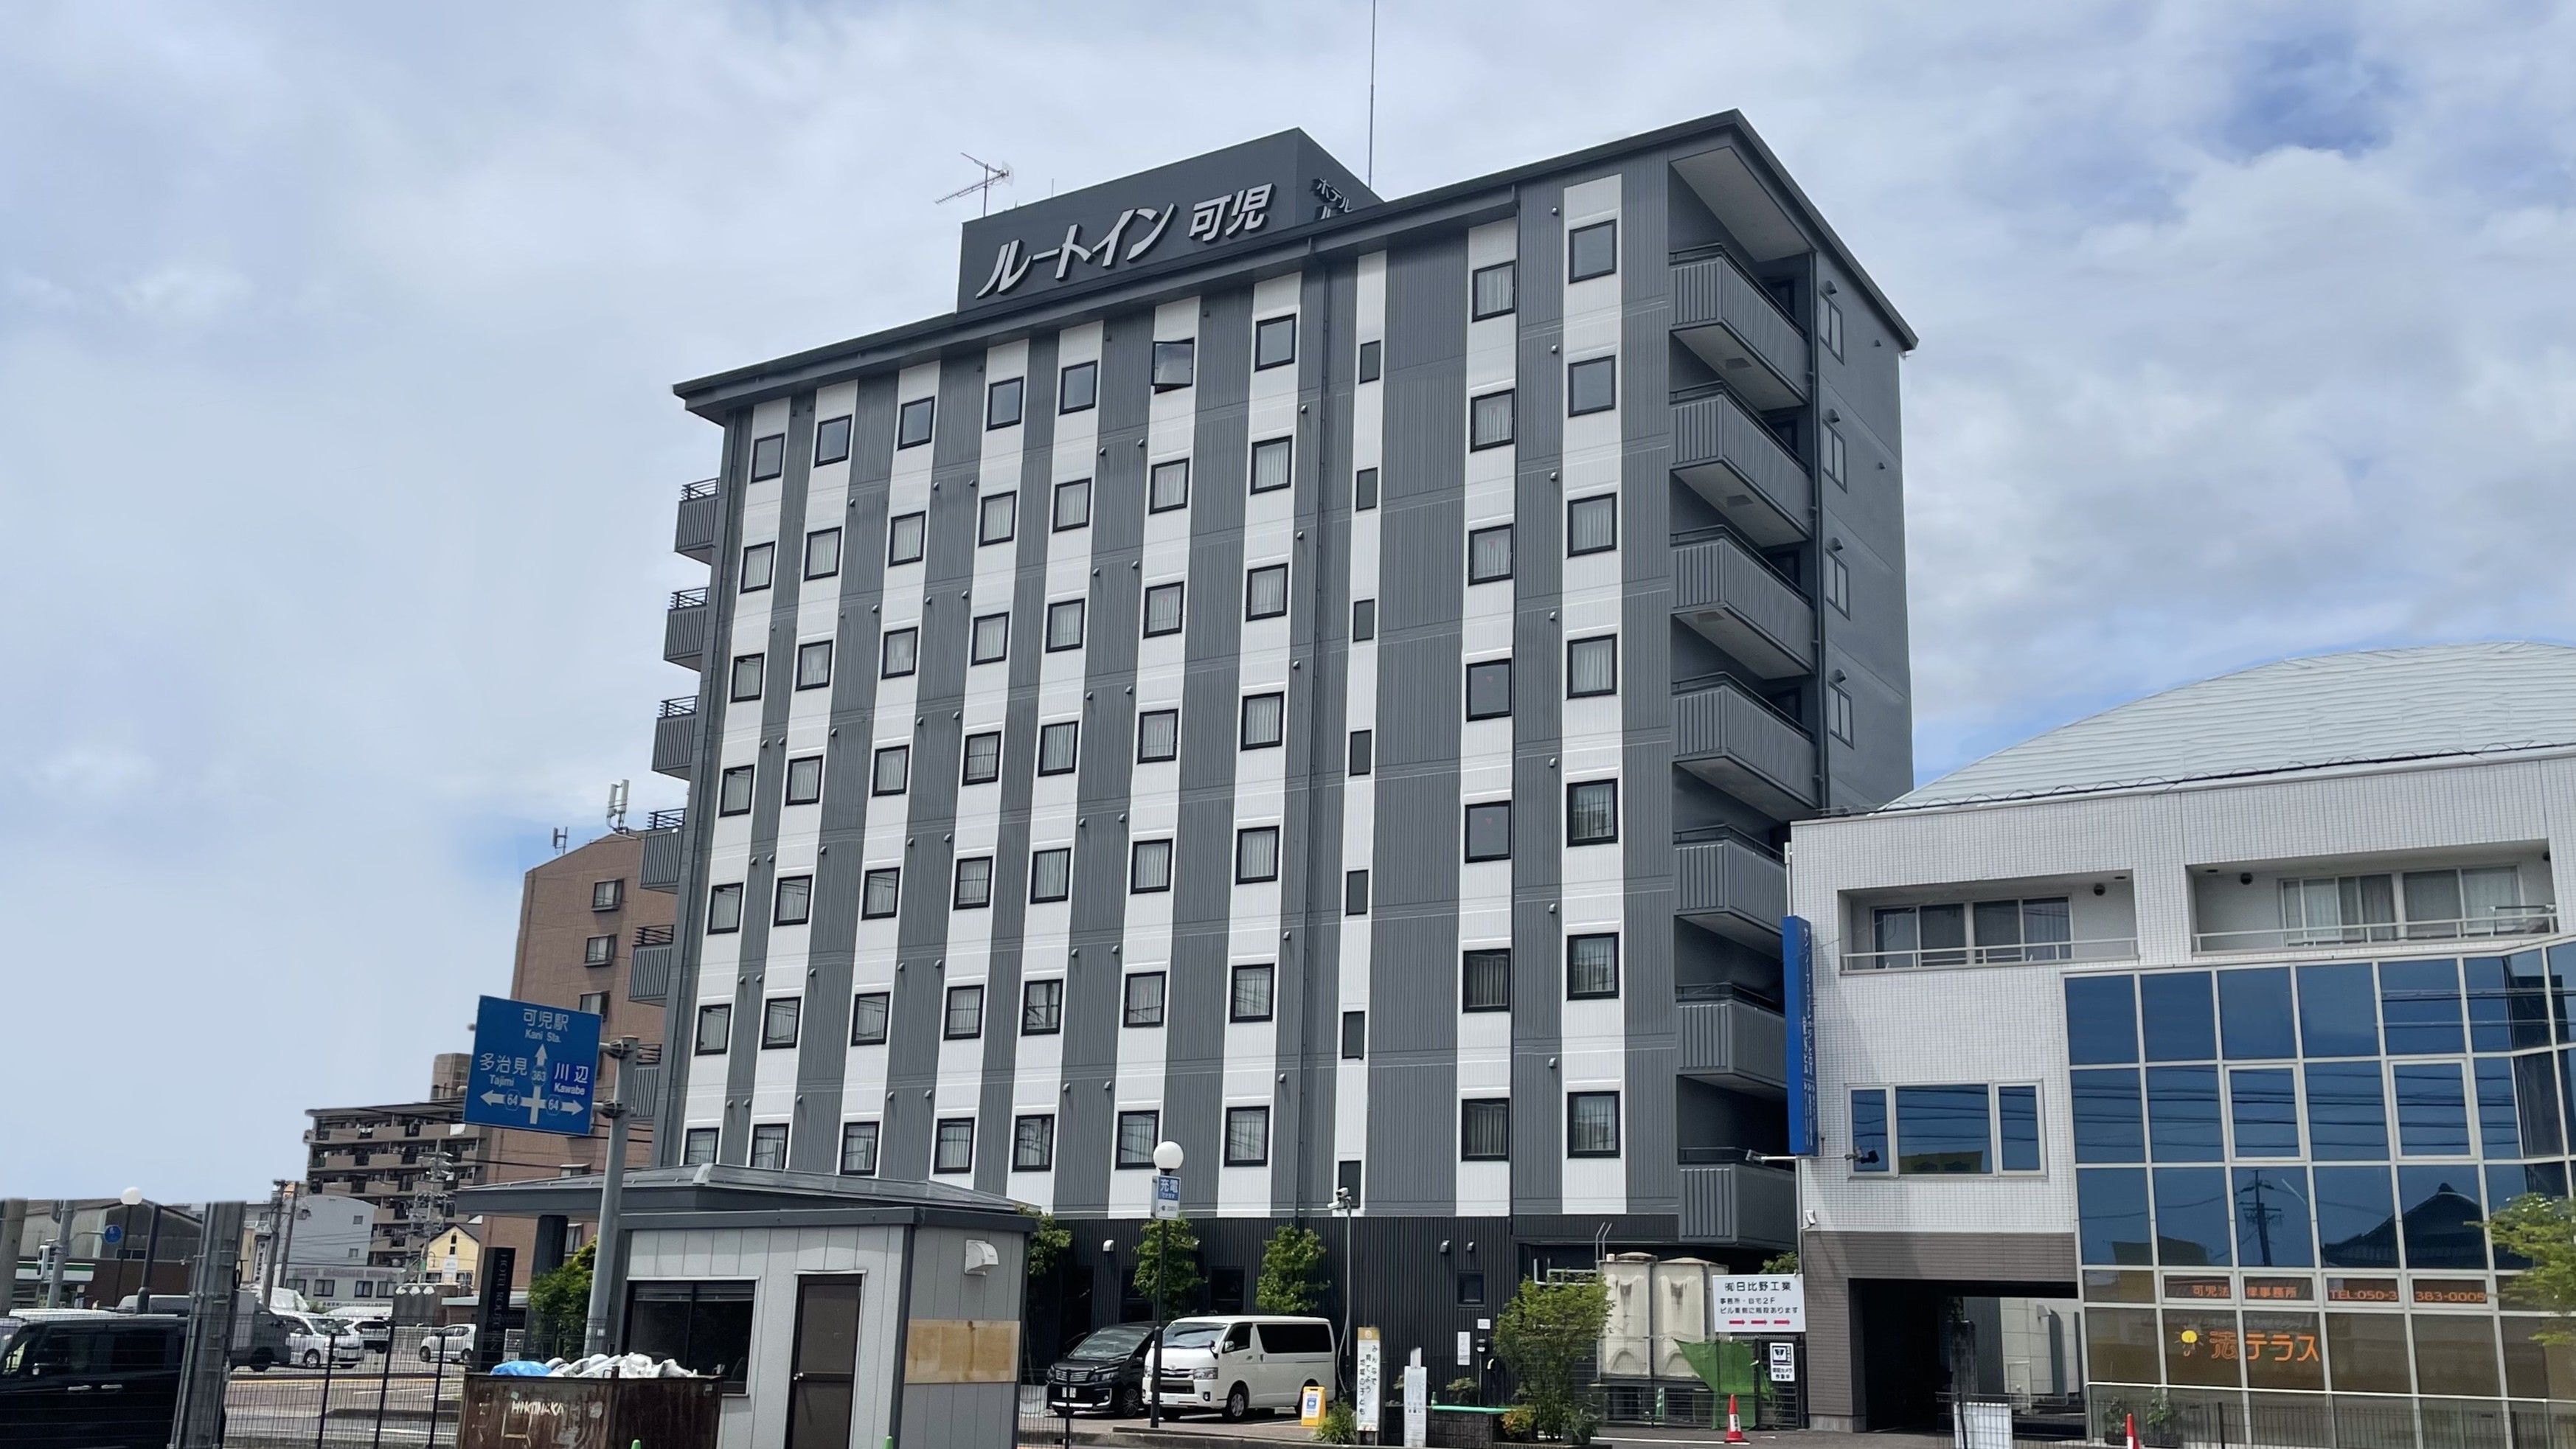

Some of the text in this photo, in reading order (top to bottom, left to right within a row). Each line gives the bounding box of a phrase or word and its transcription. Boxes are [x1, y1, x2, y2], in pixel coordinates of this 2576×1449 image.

[1316, 177, 1354, 213] ホテル
[976, 182, 1275, 299] ルートイン 可児
[523, 1008, 569, 1032] 可児駅
[524, 1029, 562, 1043] Kani Sta.
[479, 1052, 528, 1077] 多治見
[531, 1070, 546, 1082] 363
[554, 1062, 589, 1084] 川辺
[489, 1074, 515, 1087] Tajimi
[554, 1083, 586, 1096] Kawabe
[506, 1094, 518, 1106] 64
[548, 1099, 559, 1111] 64
[1160, 1178, 1178, 1193] 充電
[2192, 1285, 2297, 1298] 可児法律事務所
[2209, 1330, 2319, 1362] 法テラス
